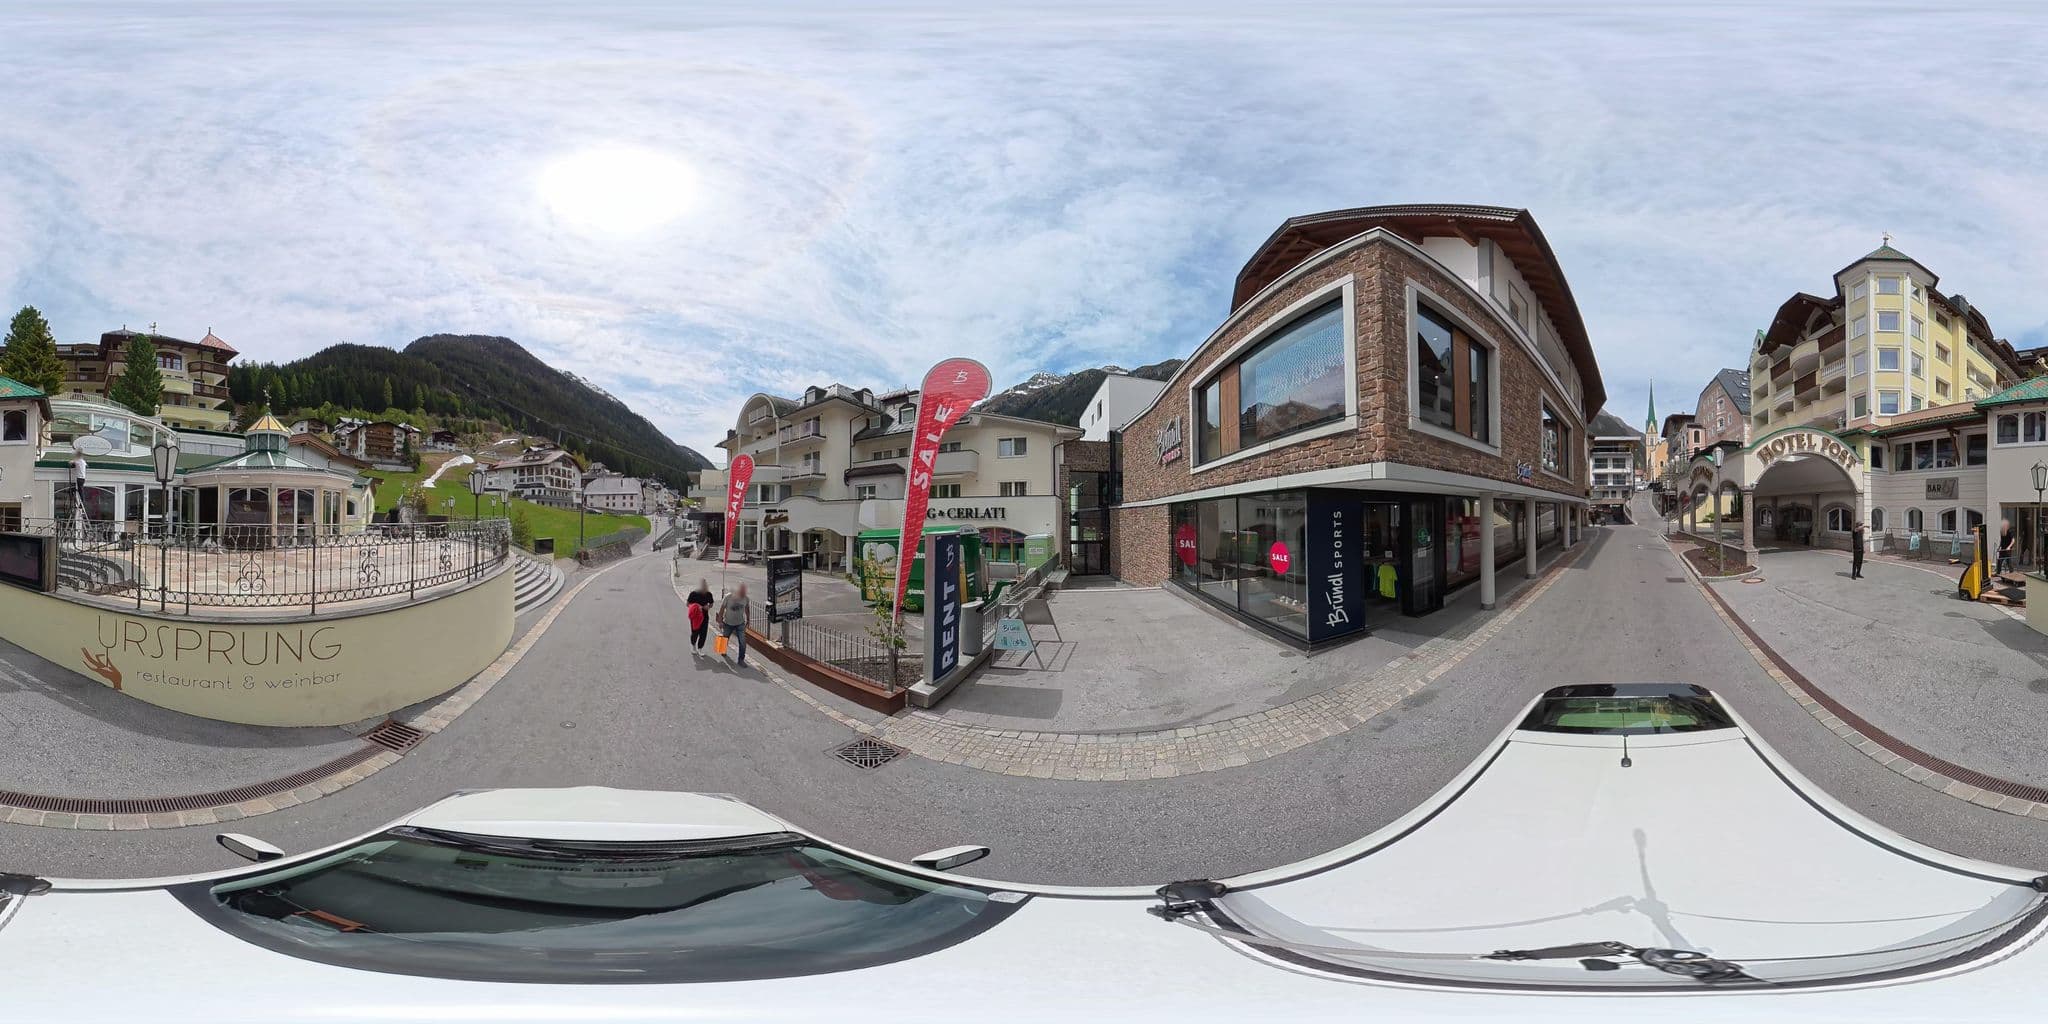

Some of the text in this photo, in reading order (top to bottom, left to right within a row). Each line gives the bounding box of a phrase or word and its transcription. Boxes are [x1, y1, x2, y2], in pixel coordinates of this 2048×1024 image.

[914, 403, 953, 490] SALE
[1757, 433, 1856, 469] HOTEL POST
[728, 480, 744, 519] SALE
[1928, 484, 1941, 492] BAR
[947, 507, 1006, 519] CERLATI
[1180, 539, 1196, 548] SAL
[1272, 553, 1288, 562] SALE
[1333, 511, 1343, 568] SPORTS
[99, 615, 342, 666] URSPRUNG
[942, 581, 955, 669] RENT
[136, 669, 342, 689] restaurant & weinbar
